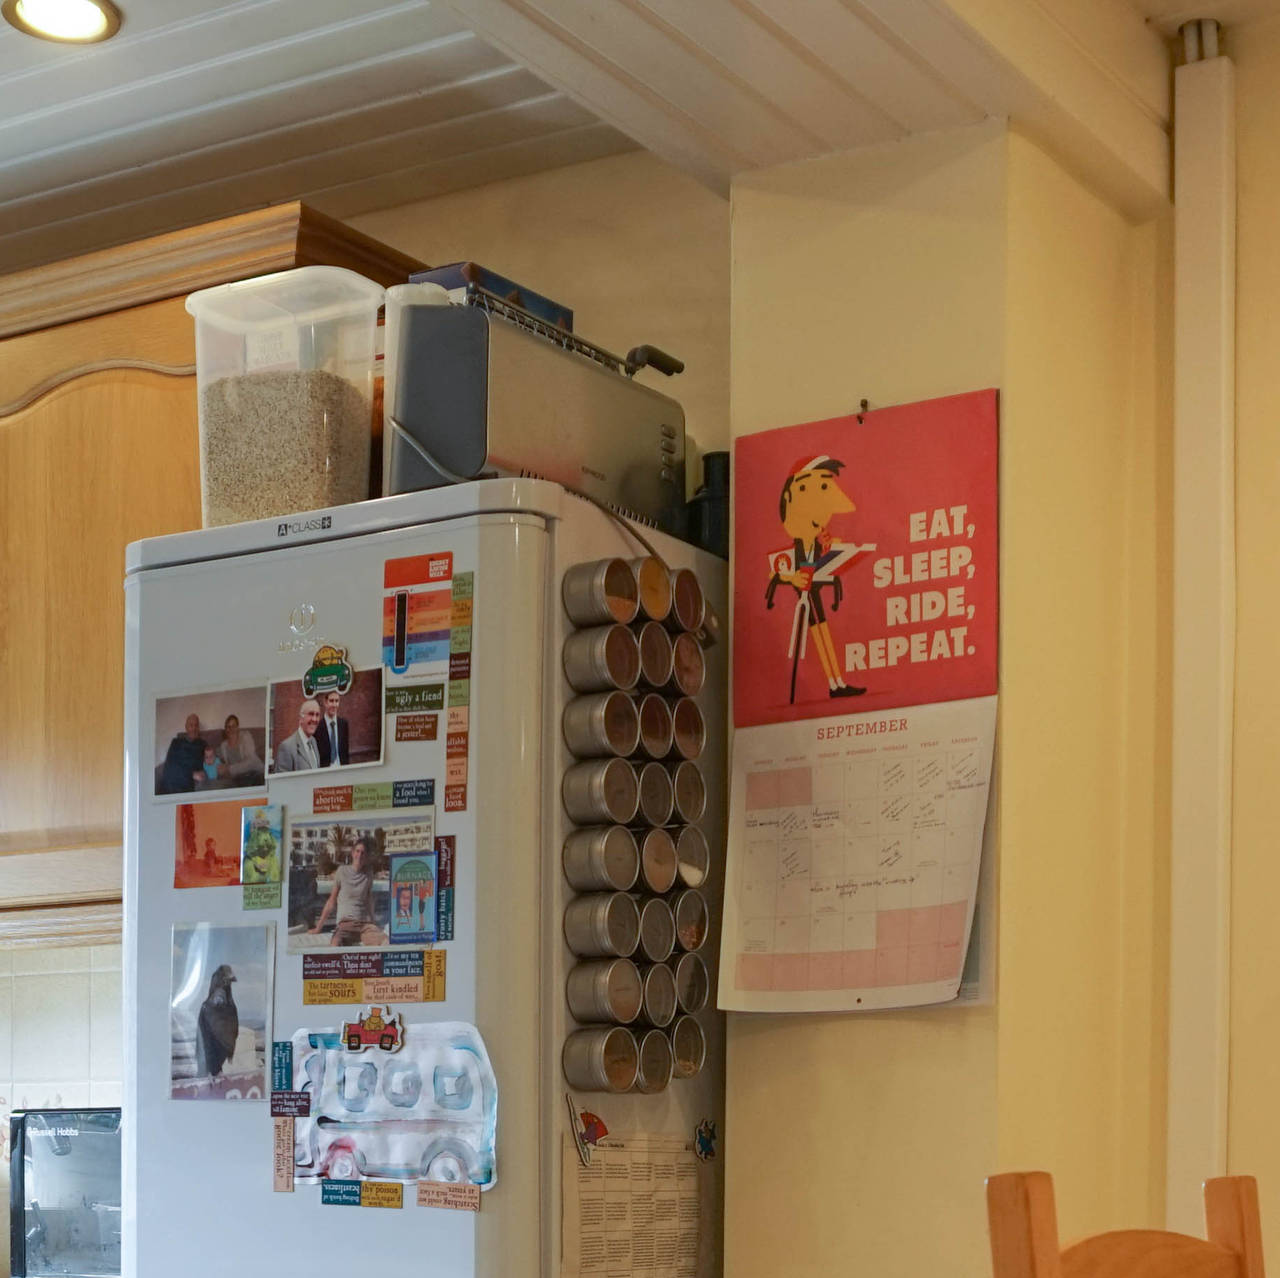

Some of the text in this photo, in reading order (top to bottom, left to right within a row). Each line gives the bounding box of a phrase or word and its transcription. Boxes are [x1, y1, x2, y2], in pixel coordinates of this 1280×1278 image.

[909, 504, 975, 543] EAT,
[873, 545, 975, 588] SLEEP,
[886, 586, 975, 627] RIDE,
[845, 626, 975, 673] REPEAT.
[817, 718, 908, 740] SEPTEMBER
[329, 988, 357, 999] sours
[57, 1127, 79, 1136] Hobbs
